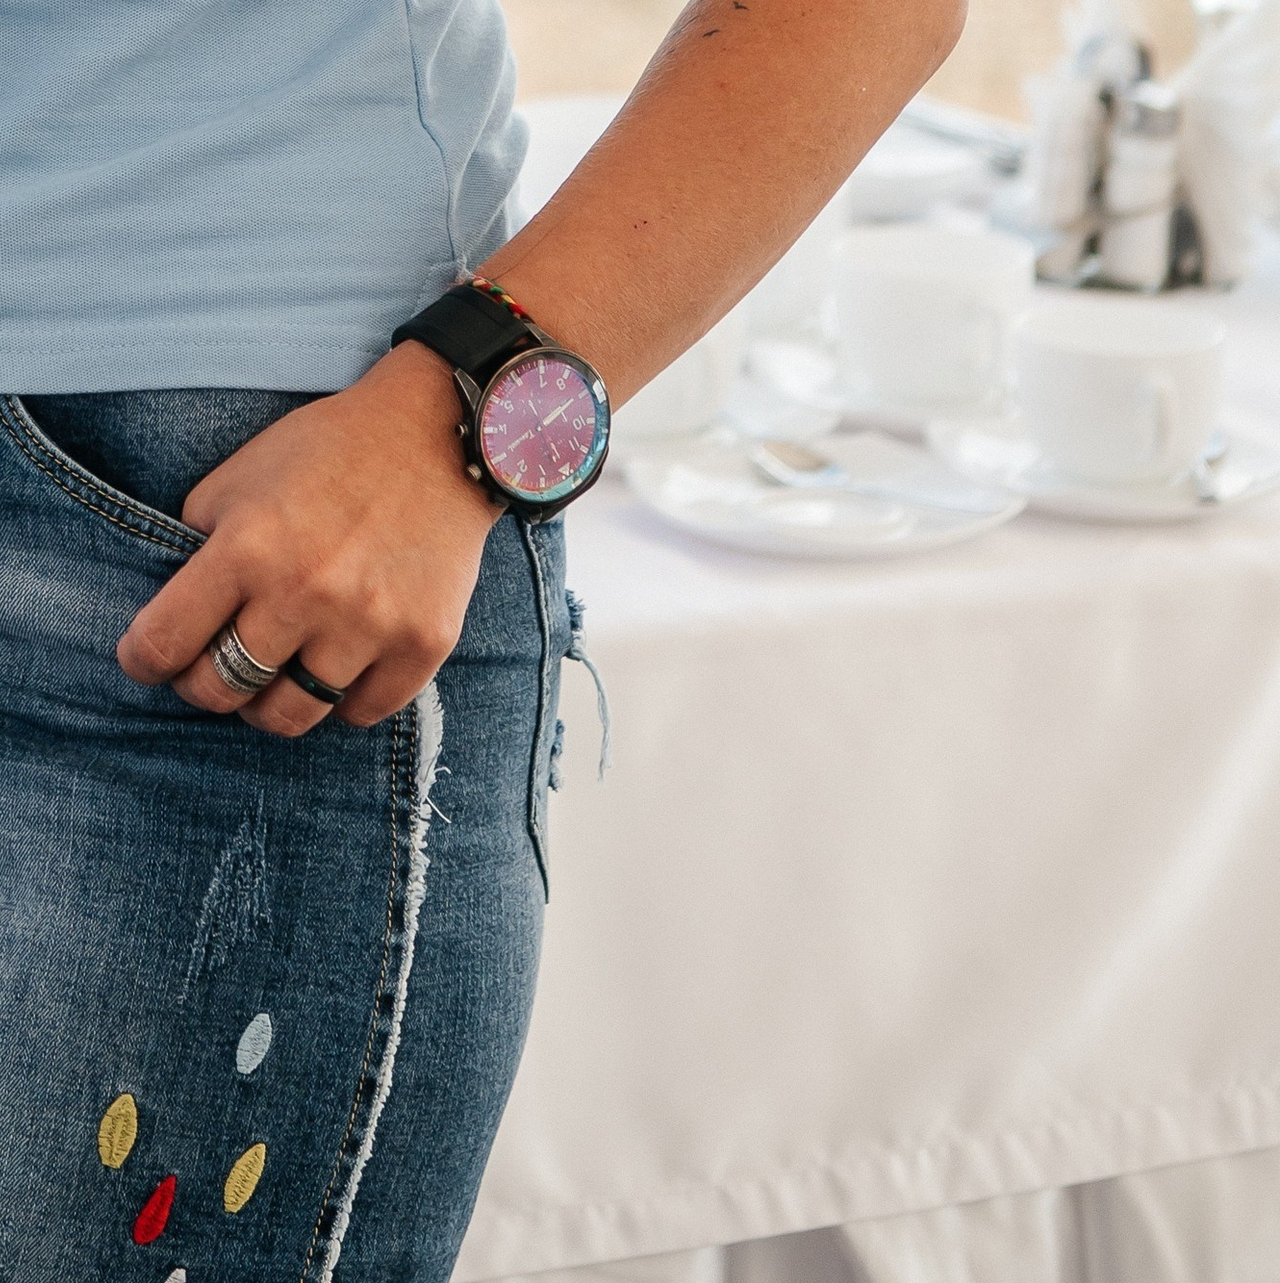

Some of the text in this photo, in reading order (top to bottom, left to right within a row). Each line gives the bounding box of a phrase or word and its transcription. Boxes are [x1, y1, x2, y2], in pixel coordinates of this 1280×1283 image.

[539, 375, 548, 388] 7
[556, 378, 566, 390] 8
[517, 459, 528, 473] 2
